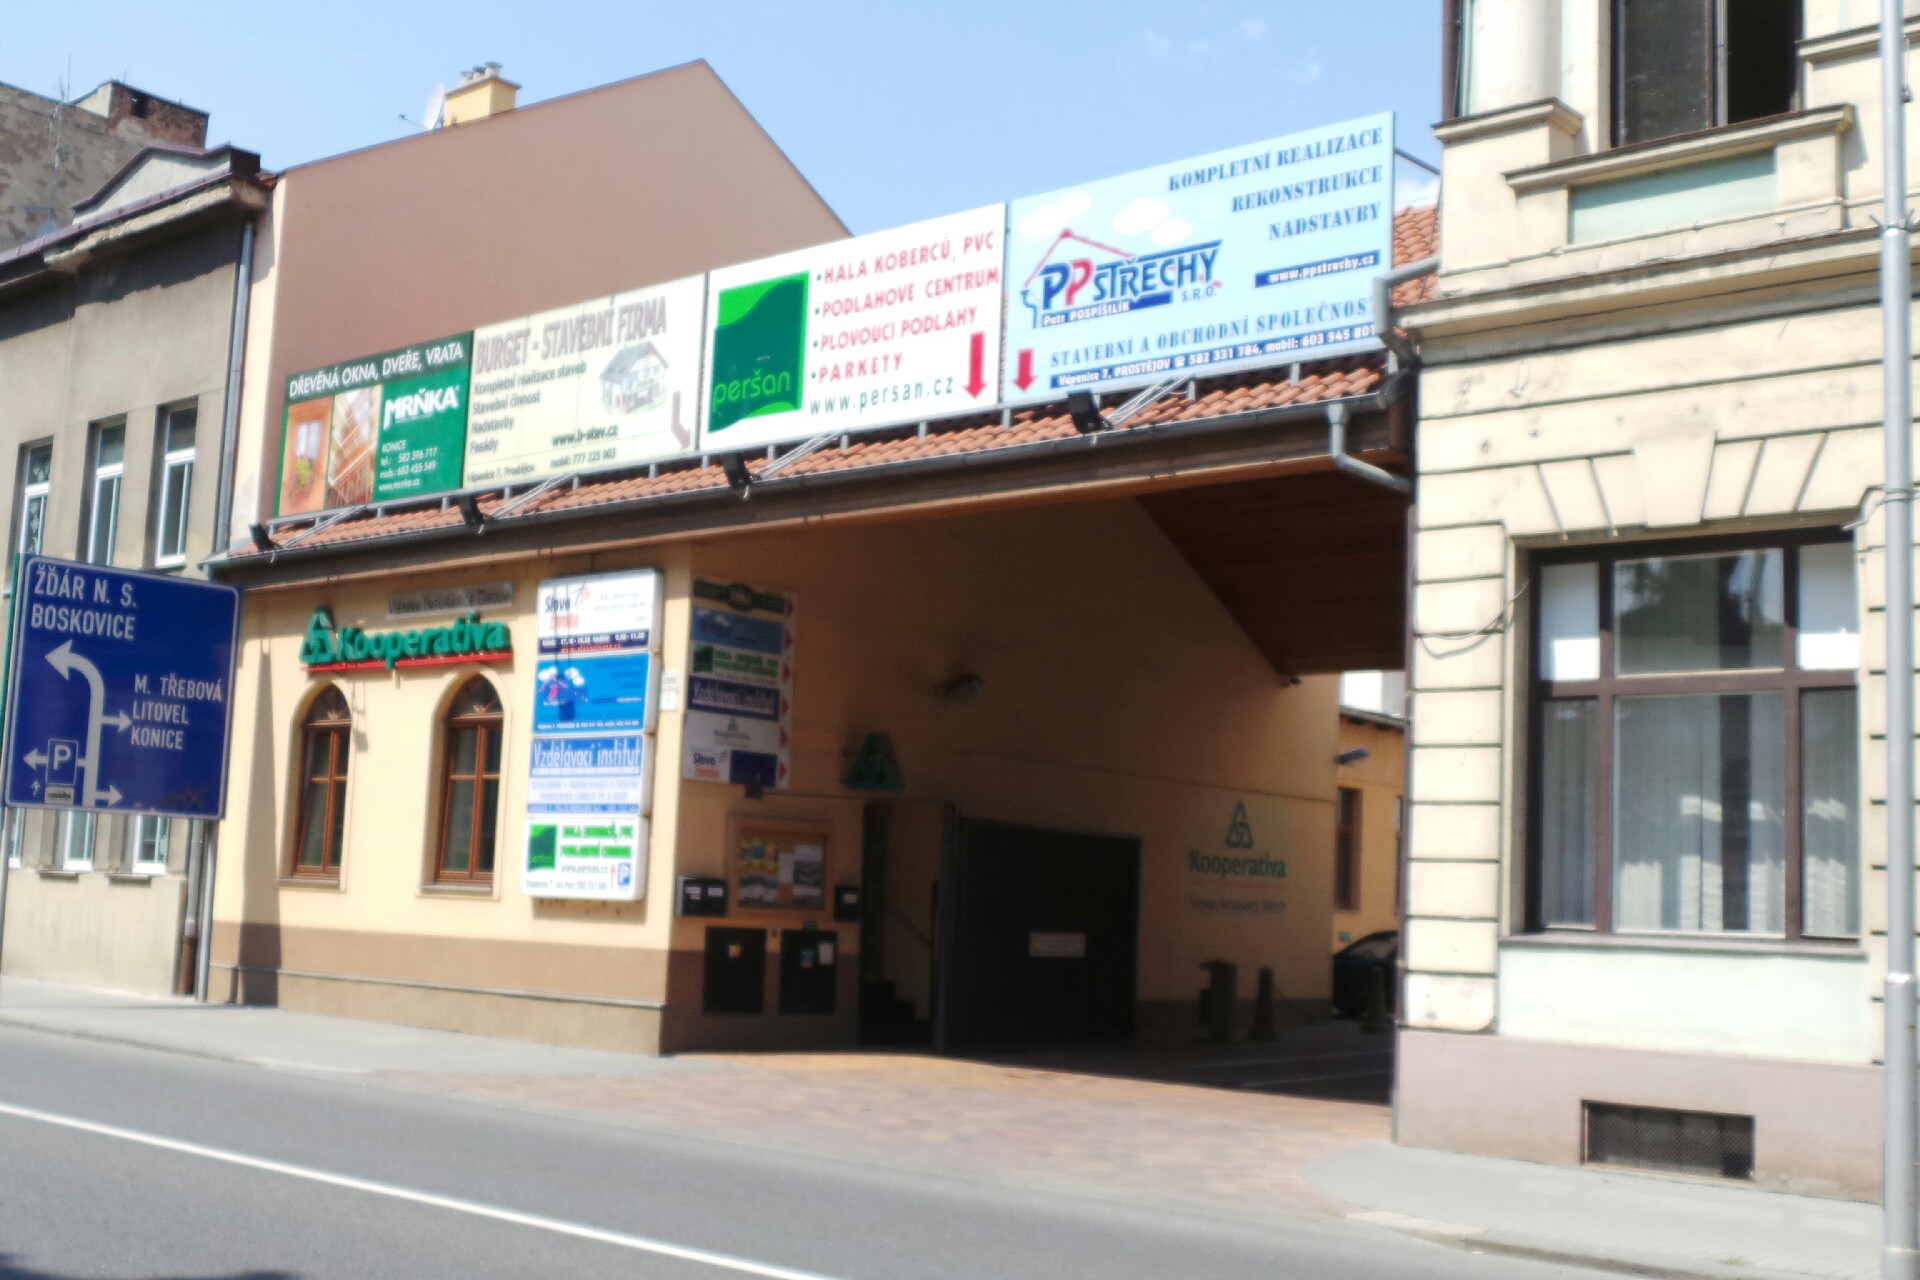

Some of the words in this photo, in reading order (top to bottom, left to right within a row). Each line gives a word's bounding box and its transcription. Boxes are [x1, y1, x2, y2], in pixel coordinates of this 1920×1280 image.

[1169, 150, 1271, 191] KOMPLETNÍ
[1277, 127, 1383, 167] REALIZACE
[1232, 165, 1383, 213] REKONSTRUKCE
[1269, 202, 1382, 240] NADSTAVBY
[823, 259, 868, 284] HALA
[874, 235, 957, 274] KOBERCŮ,
[963, 230, 995, 254] PVC
[1269, 253, 1374, 283] www.ppstrechy.cz
[924, 266, 1000, 299] CENTRUM
[475, 327, 531, 374] BURGET
[541, 304, 615, 361] STAVEBNÍ
[617, 296, 667, 343] FIRMA
[901, 305, 978, 337] PODLAHY
[1051, 336, 1134, 367] STAVEBNÍ
[1140, 338, 1150, 352] A
[1157, 314, 1249, 350] OBCHODNÍ
[1256, 297, 1376, 333] SPOLEČNOS
[289, 367, 339, 398] DŘEVĚNÁ
[341, 362, 379, 385] OKNA,
[382, 349, 422, 377] DVEŘE,
[425, 342, 463, 365] VRATA
[818, 352, 903, 384] PARKETY
[1114, 357, 1171, 378] PROSTĚJOV
[1189, 352, 1210, 365] 582
[1213, 347, 1234, 361] 331
[1266, 338, 1299, 353] mobil:
[1302, 333, 1324, 346] 603
[1328, 329, 1350, 343] 545
[474, 373, 516, 396] Kompletní
[517, 368, 556, 386] realizace
[557, 360, 588, 378] staveb
[713, 368, 791, 411] peršan
[809, 376, 954, 416] www.persan.cz
[383, 387, 459, 431] MRŇKA
[473, 395, 509, 415] Stavební
[509, 390, 542, 407] činnost
[472, 416, 514, 435] Nadstavby
[470, 438, 499, 453] Fasády
[34, 564, 84, 601] ŽĎÁR
[94, 579, 110, 604] N.
[120, 583, 137, 608] S.
[31, 603, 136, 640] BOSKOVICE
[336, 611, 510, 669] Kooperativa
[134, 674, 151, 696] M.
[160, 673, 222, 702] TŘEBOVÁ
[132, 700, 189, 725] LITOVEL
[131, 726, 184, 749] KONICE
[534, 739, 594, 767] Vzdělávací
[597, 737, 641, 767] institut
[1189, 848, 1287, 879] Kooperativa
